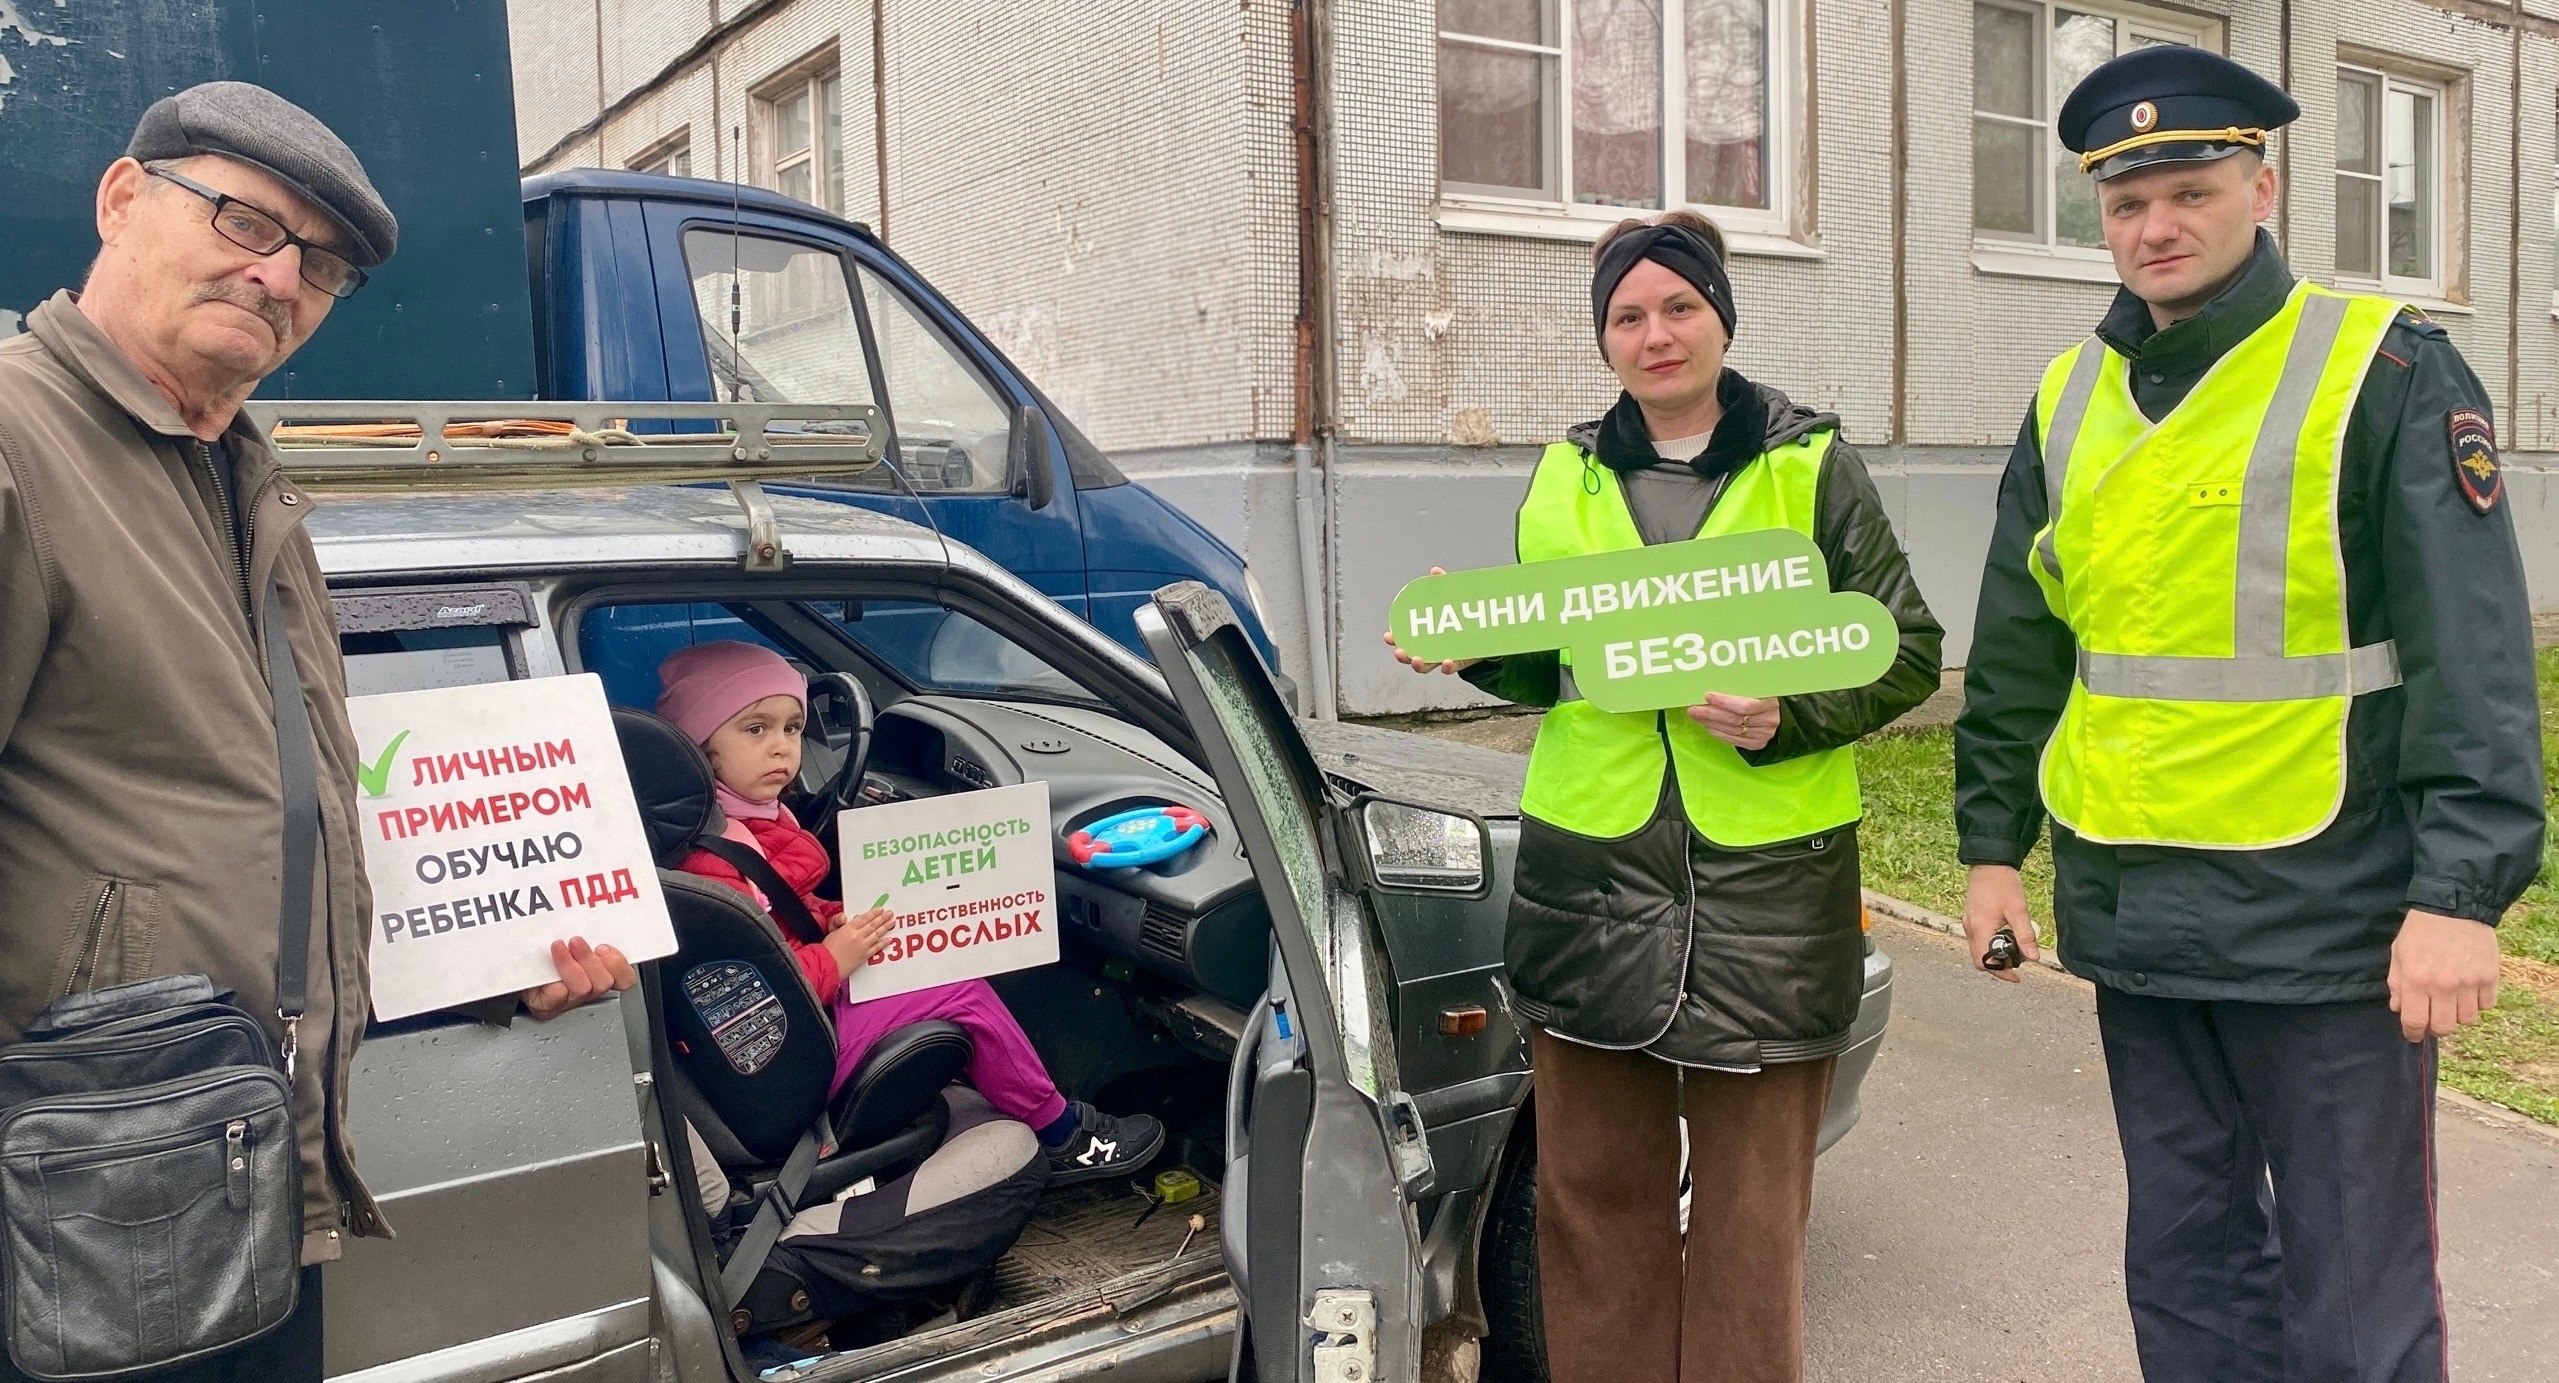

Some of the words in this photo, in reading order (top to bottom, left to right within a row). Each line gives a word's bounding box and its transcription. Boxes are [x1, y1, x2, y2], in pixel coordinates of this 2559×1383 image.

[1409, 591, 1547, 637] НАЧНИ
[1559, 555, 1813, 625] ДВИЖЕНИЕ
[411, 738, 577, 788] ЛИЧНЫМ
[377, 782, 592, 842] ПРИМЕРОМ
[415, 831, 583, 885] ОБУЧАЮ
[862, 818, 1031, 860] БЕЗОПАСНОСТЬ
[901, 839, 997, 887] ДЕТЕЙ
[380, 886, 555, 945] РЕБЕНКА
[559, 867, 640, 909] ПДД
[888, 890, 1045, 930] ТВЕТСТВЕННОСТЬ
